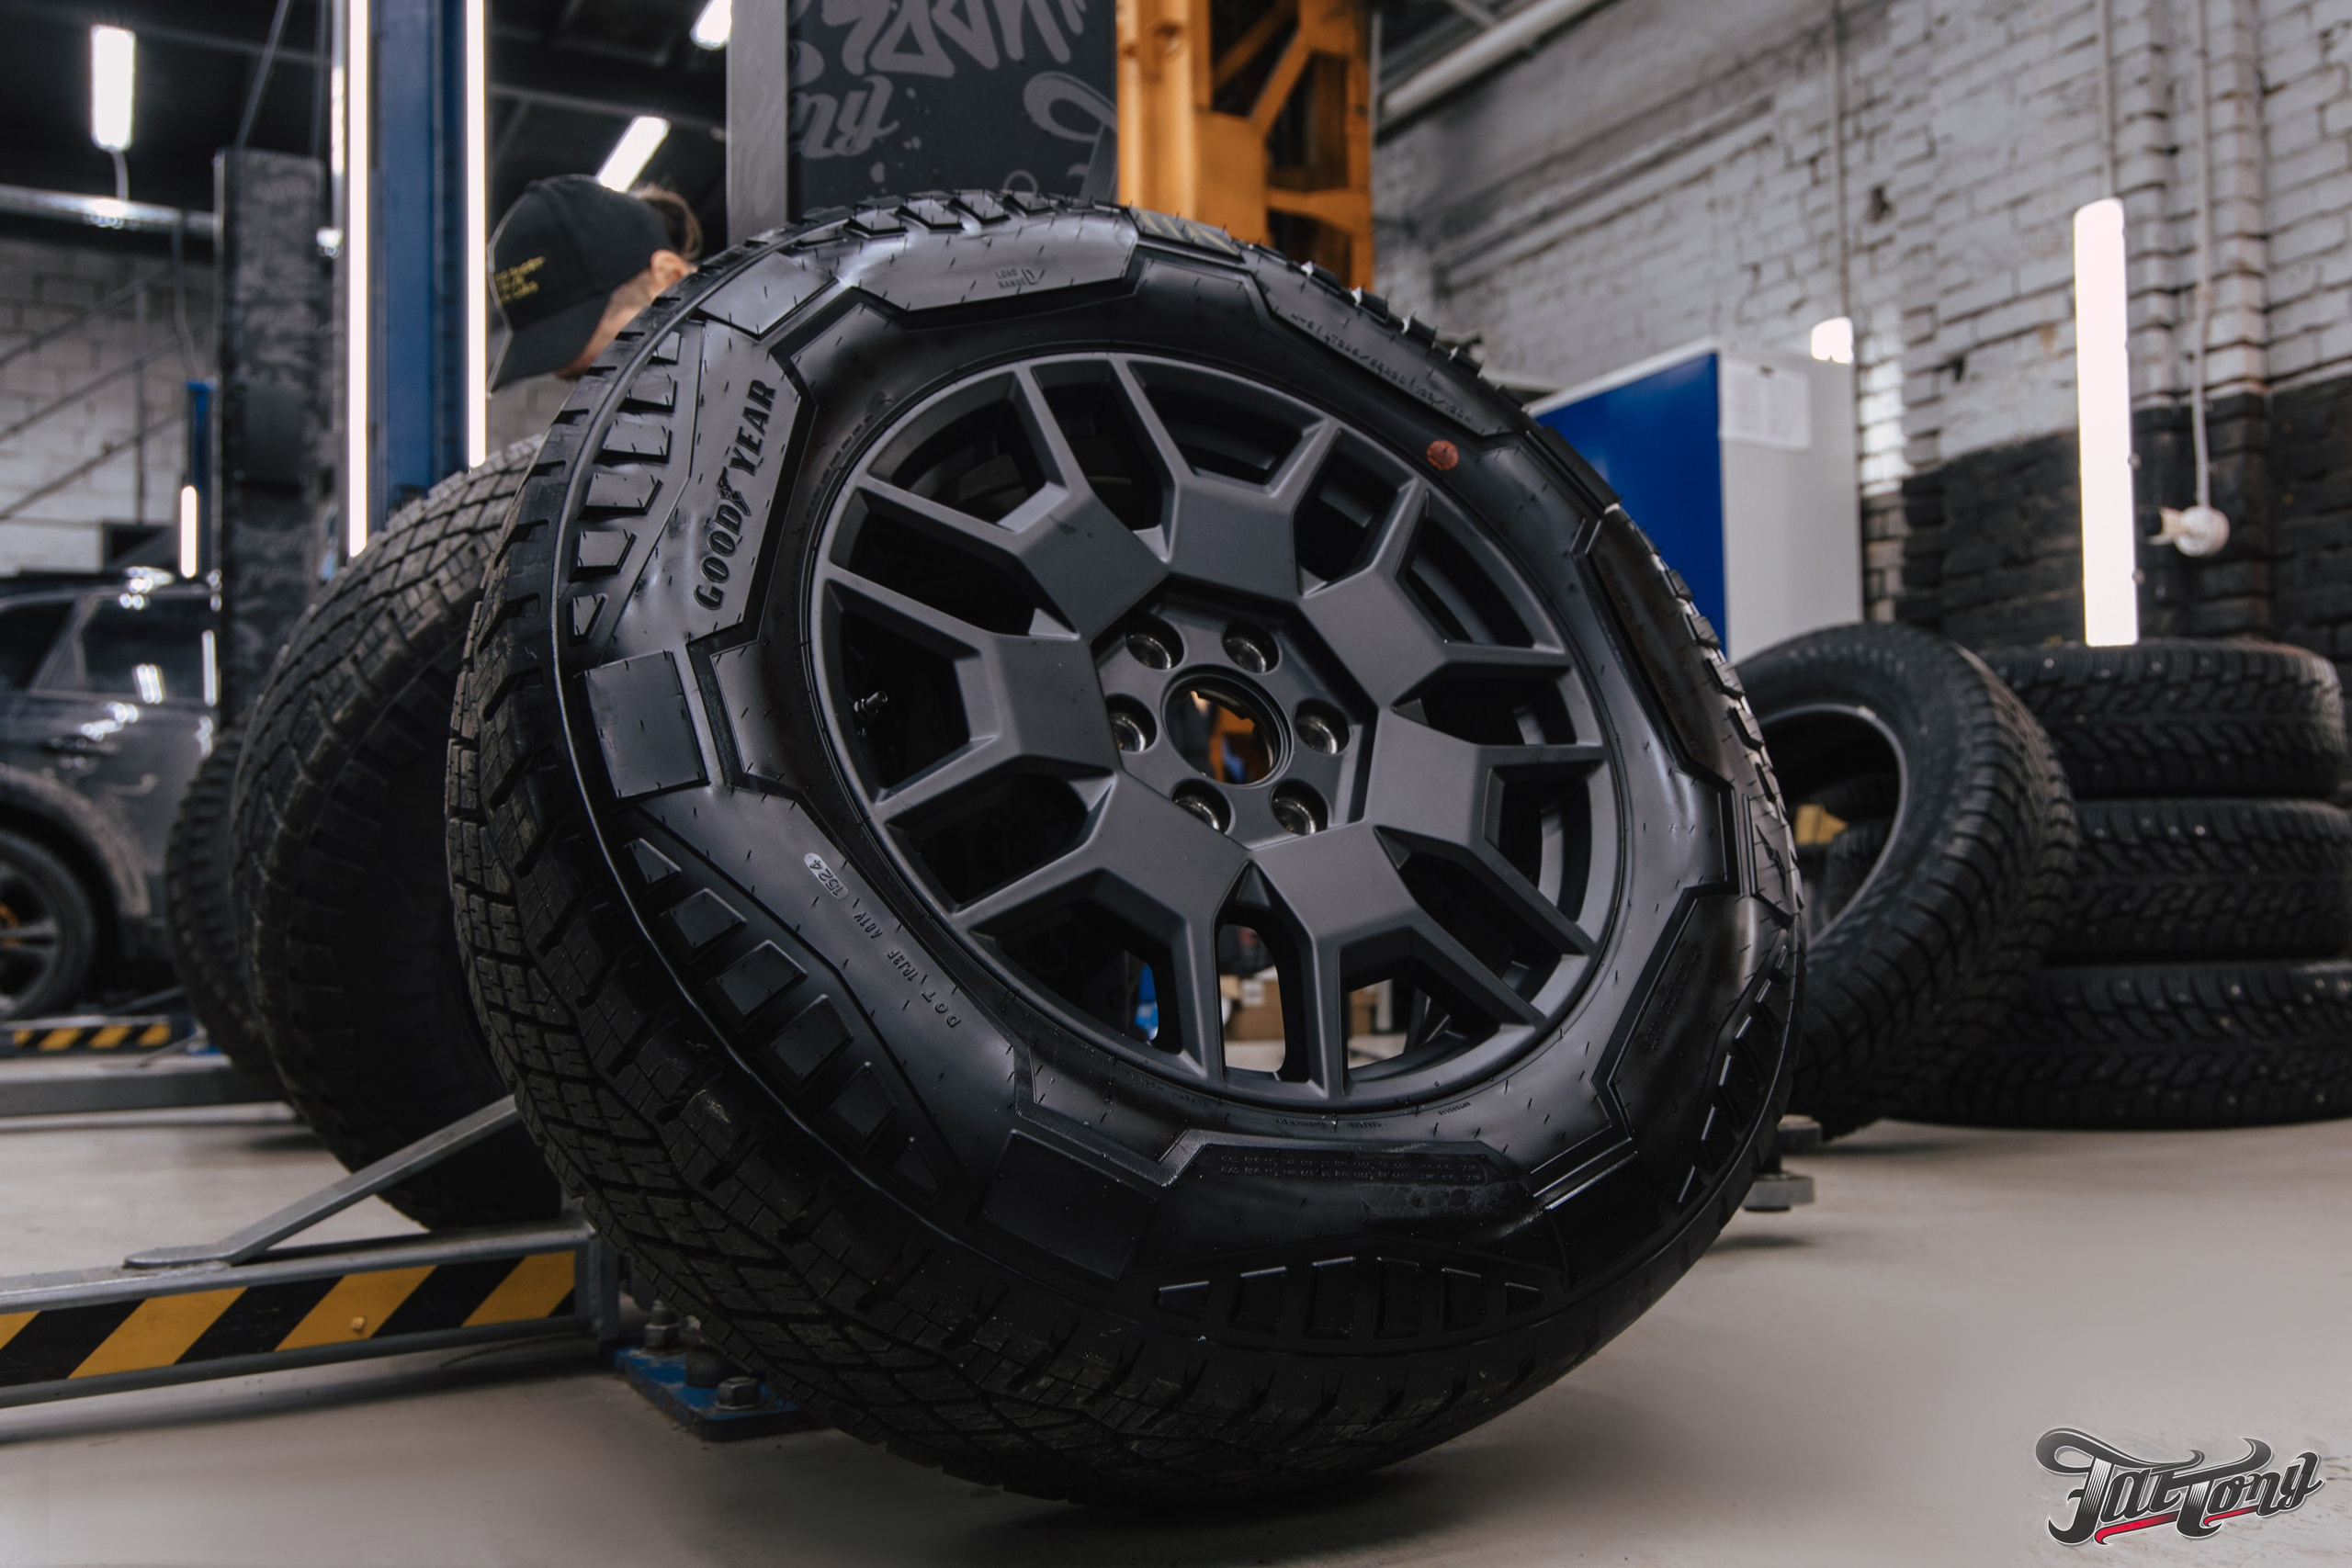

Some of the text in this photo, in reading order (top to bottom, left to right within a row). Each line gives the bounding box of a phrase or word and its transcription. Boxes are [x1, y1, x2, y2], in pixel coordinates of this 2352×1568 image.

[694, 379, 776, 611] GOODYEAR
[808, 859, 844, 897] 1524
[921, 990, 962, 1029] DOT
